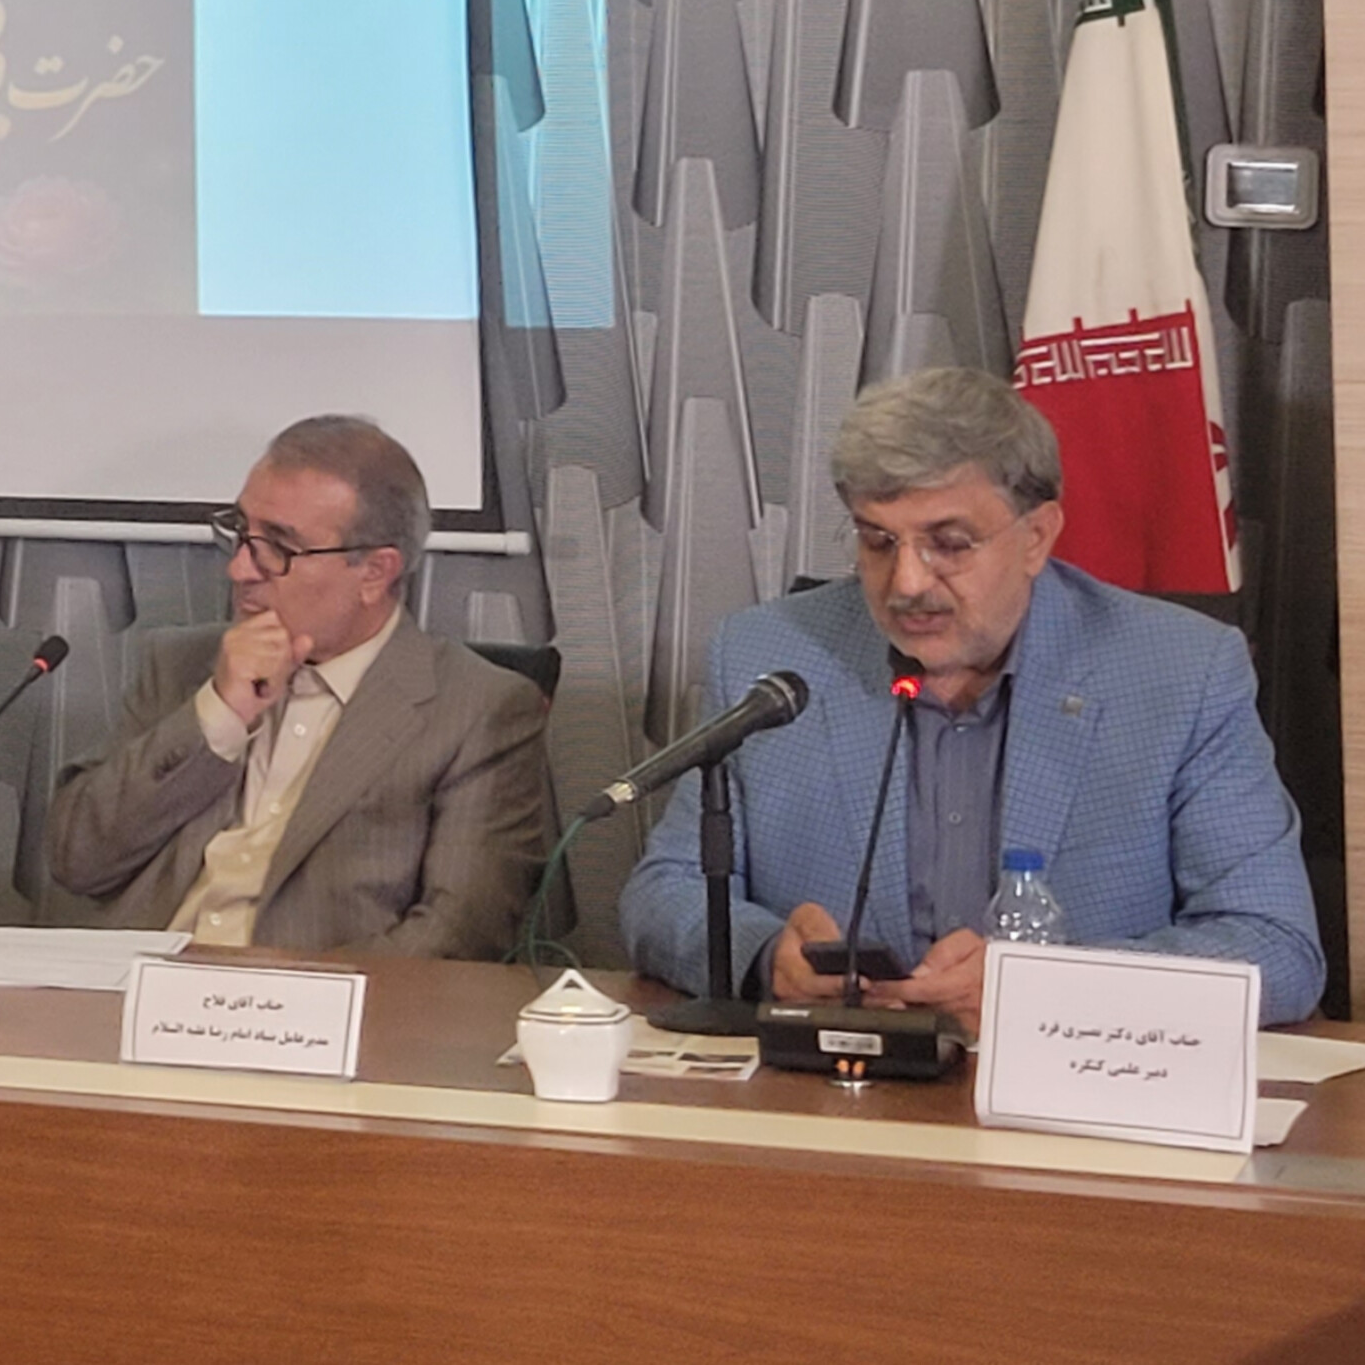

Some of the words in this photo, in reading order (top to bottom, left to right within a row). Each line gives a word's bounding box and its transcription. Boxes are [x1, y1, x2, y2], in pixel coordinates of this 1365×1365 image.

[7, 33, 165, 143] حضرت
[202, 994, 225, 1009] فلاح
[227, 995, 254, 1010] آقای
[256, 998, 284, 1010] جناب
[1105, 1027, 1132, 1043] دکتر
[1135, 1029, 1165, 1045] آقای
[1169, 1035, 1201, 1046] جناب
[1070, 1059, 1105, 1074] کنگره
[1107, 1062, 1140, 1077] علمی
[1143, 1068, 1168, 1080] دبیر
